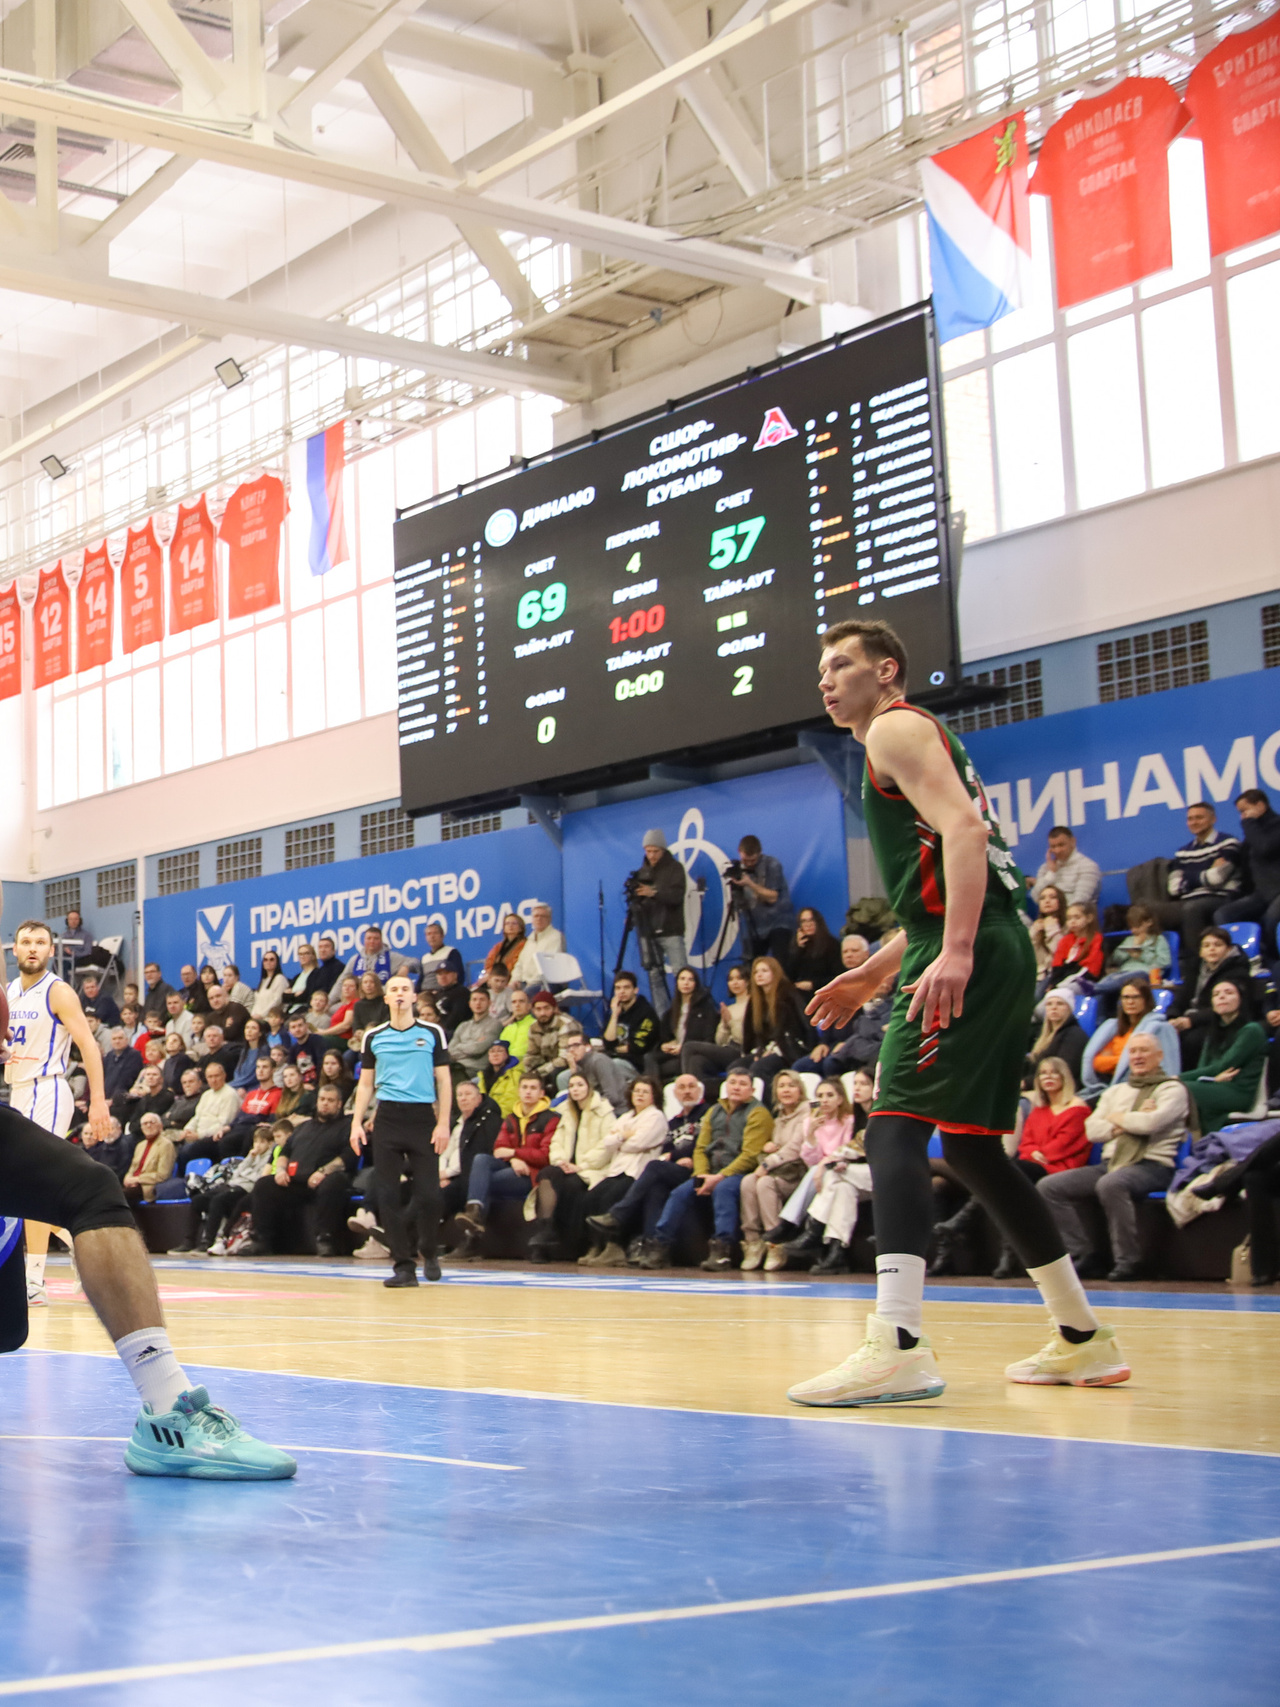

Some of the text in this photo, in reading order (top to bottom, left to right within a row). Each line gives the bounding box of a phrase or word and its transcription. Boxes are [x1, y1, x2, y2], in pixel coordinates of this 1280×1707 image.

[649, 420, 714, 456] СШОР-
[621, 433, 747, 492] ЛОКОМОТИВ-
[646, 466, 722, 507] КУБАНЬ
[520, 486, 595, 531] ДИНАМО
[605, 521, 660, 550] ПЕРИОД
[708, 515, 766, 570] 57
[179, 538, 205, 579] 14
[626, 552, 641, 573] 4
[134, 562, 148, 600] 5
[85, 581, 107, 620] 14
[517, 582, 567, 629] 69
[40, 602, 62, 638] 12
[609, 605, 665, 643] 1:00
[615, 670, 664, 701] 0:00
[732, 666, 754, 696] 2
[537, 717, 556, 743] 0
[250, 869, 481, 934] ПРАВИТЕЛЬСТВО
[9, 1011, 39, 1020] НАМО
